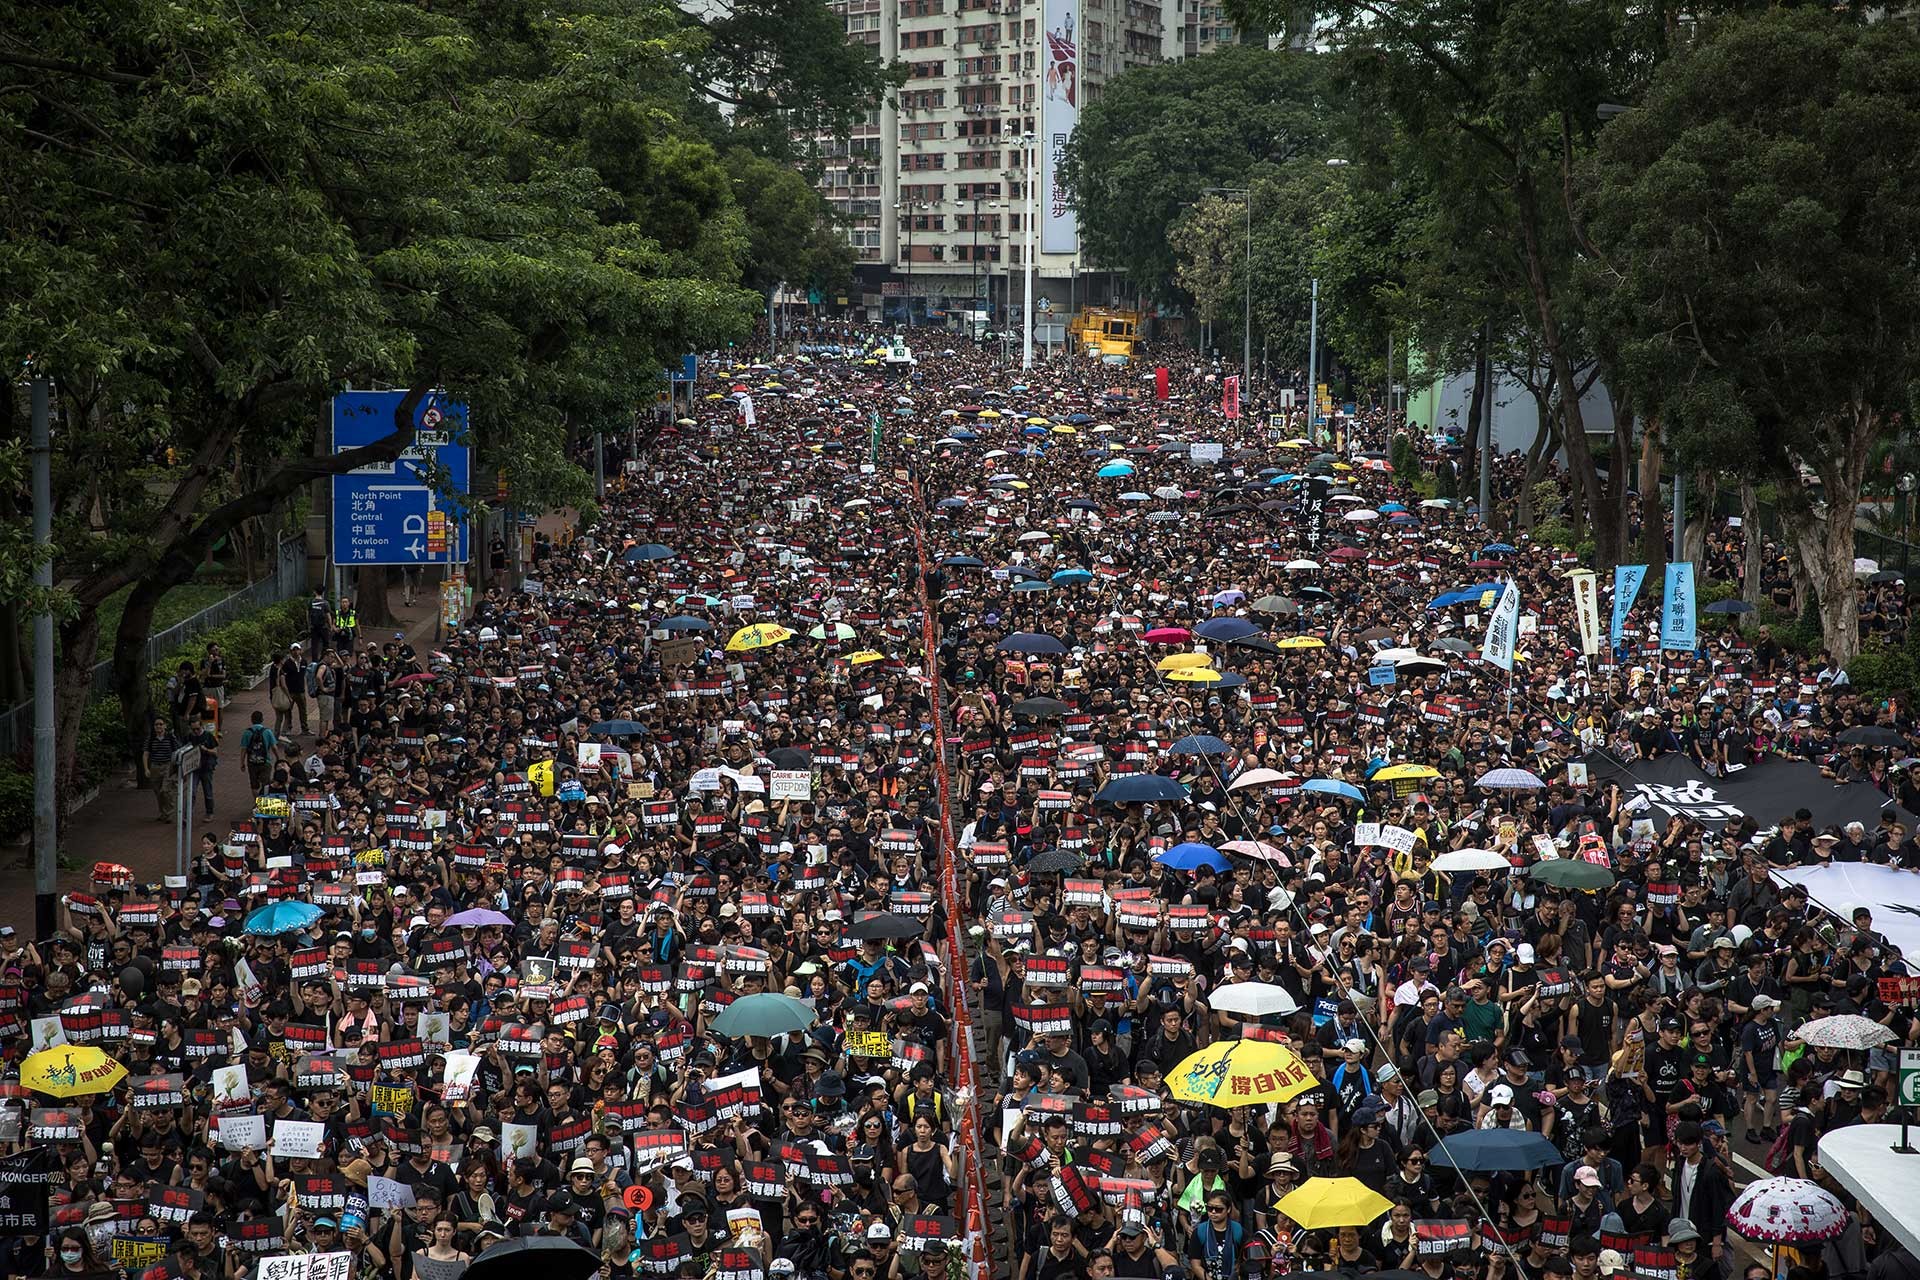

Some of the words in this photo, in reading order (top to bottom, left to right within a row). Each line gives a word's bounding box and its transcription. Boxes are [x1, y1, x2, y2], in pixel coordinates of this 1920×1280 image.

[1052, 133, 1067, 218] 同步進步
[352, 492, 377, 500] North
[379, 492, 402, 500] Point
[352, 500, 376, 511] 北角
[351, 513, 383, 521] Central
[1308, 499, 1323, 548] 反送中
[352, 525, 376, 535] 中區
[352, 549, 376, 559] 九龍
[1671, 570, 1685, 633] 家長聯盟
[796, 771, 810, 779] LAM
[775, 782, 793, 792] STEP
[386, 815, 418, 824] 沒有暴動
[644, 814, 678, 823] 沒有暴動
[400, 841, 432, 851] 沒有暴動
[1119, 915, 1159, 928] 撤回控罪
[1170, 917, 1207, 928] 撤回控罪
[433, 941, 453, 951] 學生
[570, 945, 589, 956] 學生
[426, 949, 465, 963] 沒有暴動
[358, 962, 378, 972] 學生
[559, 957, 595, 968] 沒有暴動
[726, 961, 765, 972] 沒有暴動
[1152, 962, 1192, 974] 撤回控罪
[348, 974, 386, 985] 沒有暴動
[642, 971, 662, 981] 學生
[1026, 972, 1066, 983] 撤回控罪
[677, 978, 714, 990] 沒有暴動
[1082, 981, 1123, 991] 撤回控罪
[389, 986, 428, 998] 沒有暴動
[1032, 1020, 1071, 1032] 撤回控罪
[195, 1032, 216, 1044] 學生
[847, 1032, 887, 1045] 保護下一代
[186, 1045, 228, 1057] 沒有暴動
[499, 1040, 541, 1053] 沒有暴動
[310, 1060, 334, 1072] 學生
[382, 1055, 424, 1069] 撤回控罪
[1231, 1060, 1308, 1096] 撐自由反
[145, 1079, 170, 1091] 學生
[134, 1093, 182, 1107] 沒有暴動
[45, 1112, 68, 1125] 學生
[1086, 1108, 1110, 1120] 學生
[32, 1126, 79, 1139] 沒有暴動
[1074, 1122, 1121, 1135] 沒有暴動
[817, 1159, 839, 1171] 學生
[0, 1171, 47, 1183] KONGER
[753, 1167, 776, 1181] 學生
[811, 1172, 853, 1186] 沒有暴動
[307, 1179, 333, 1192] 學生
[163, 1191, 189, 1207] 學生
[299, 1194, 344, 1208] 沒有暴動
[241, 1223, 269, 1237] 學生
[915, 1220, 941, 1235] 學生
[115, 1240, 166, 1257] 保護下一代
[653, 1243, 678, 1257] 學生
[723, 1252, 750, 1267] 學生
